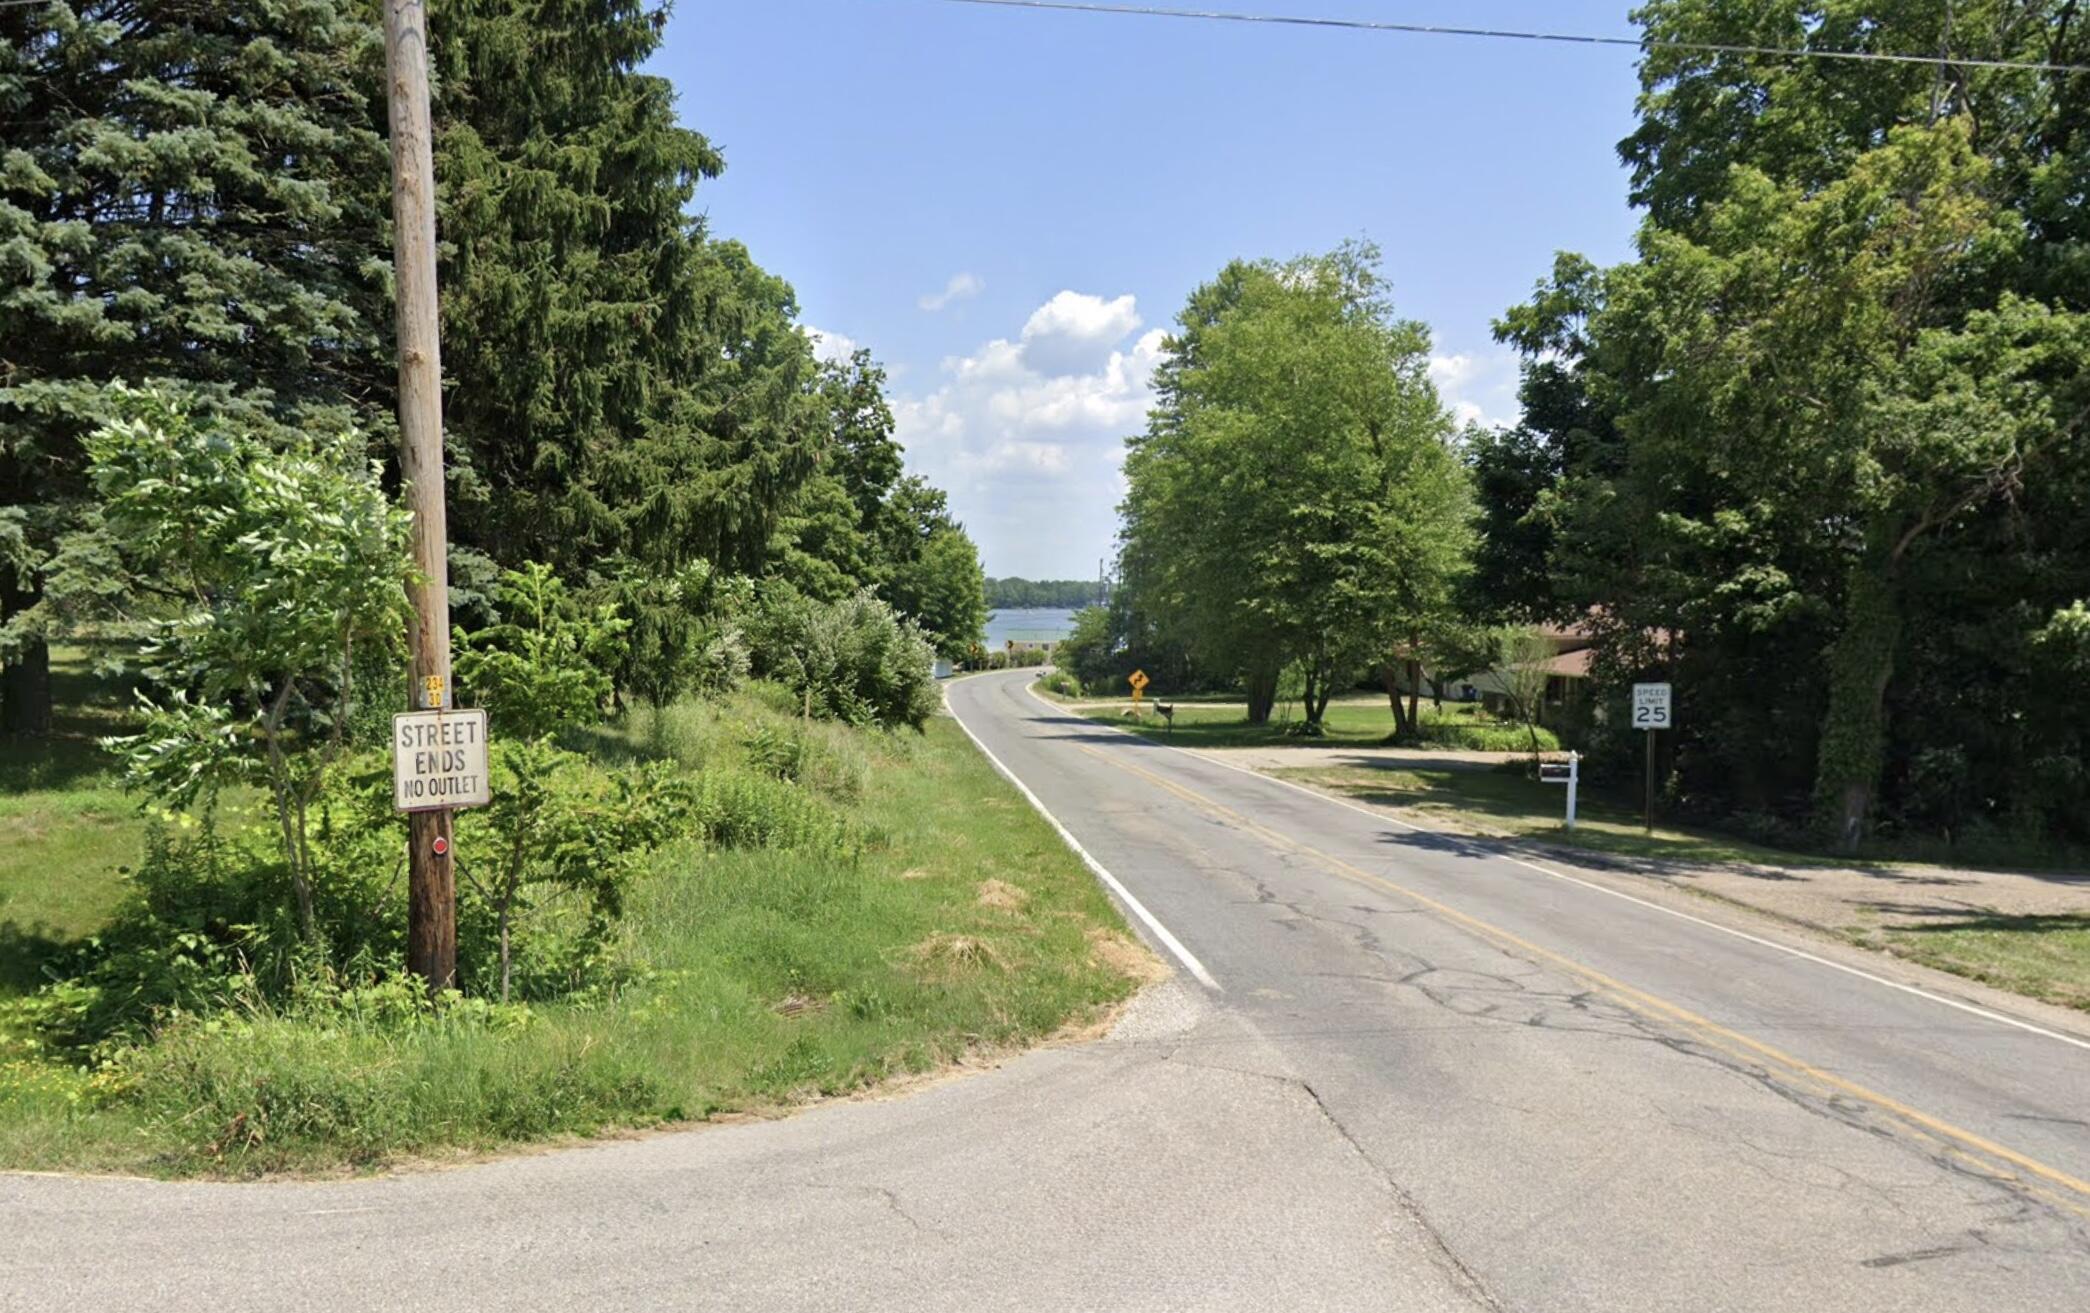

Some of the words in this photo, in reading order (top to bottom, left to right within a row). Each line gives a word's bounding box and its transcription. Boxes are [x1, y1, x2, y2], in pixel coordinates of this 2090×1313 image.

[1637, 688, 1667, 696] SPEED
[1639, 697, 1664, 705] LIMIT
[1637, 706, 1667, 722] 25
[401, 721, 476, 748] STREET
[415, 749, 466, 775] ENDS
[404, 779, 424, 798] NO
[429, 775, 478, 796] OUTLET
